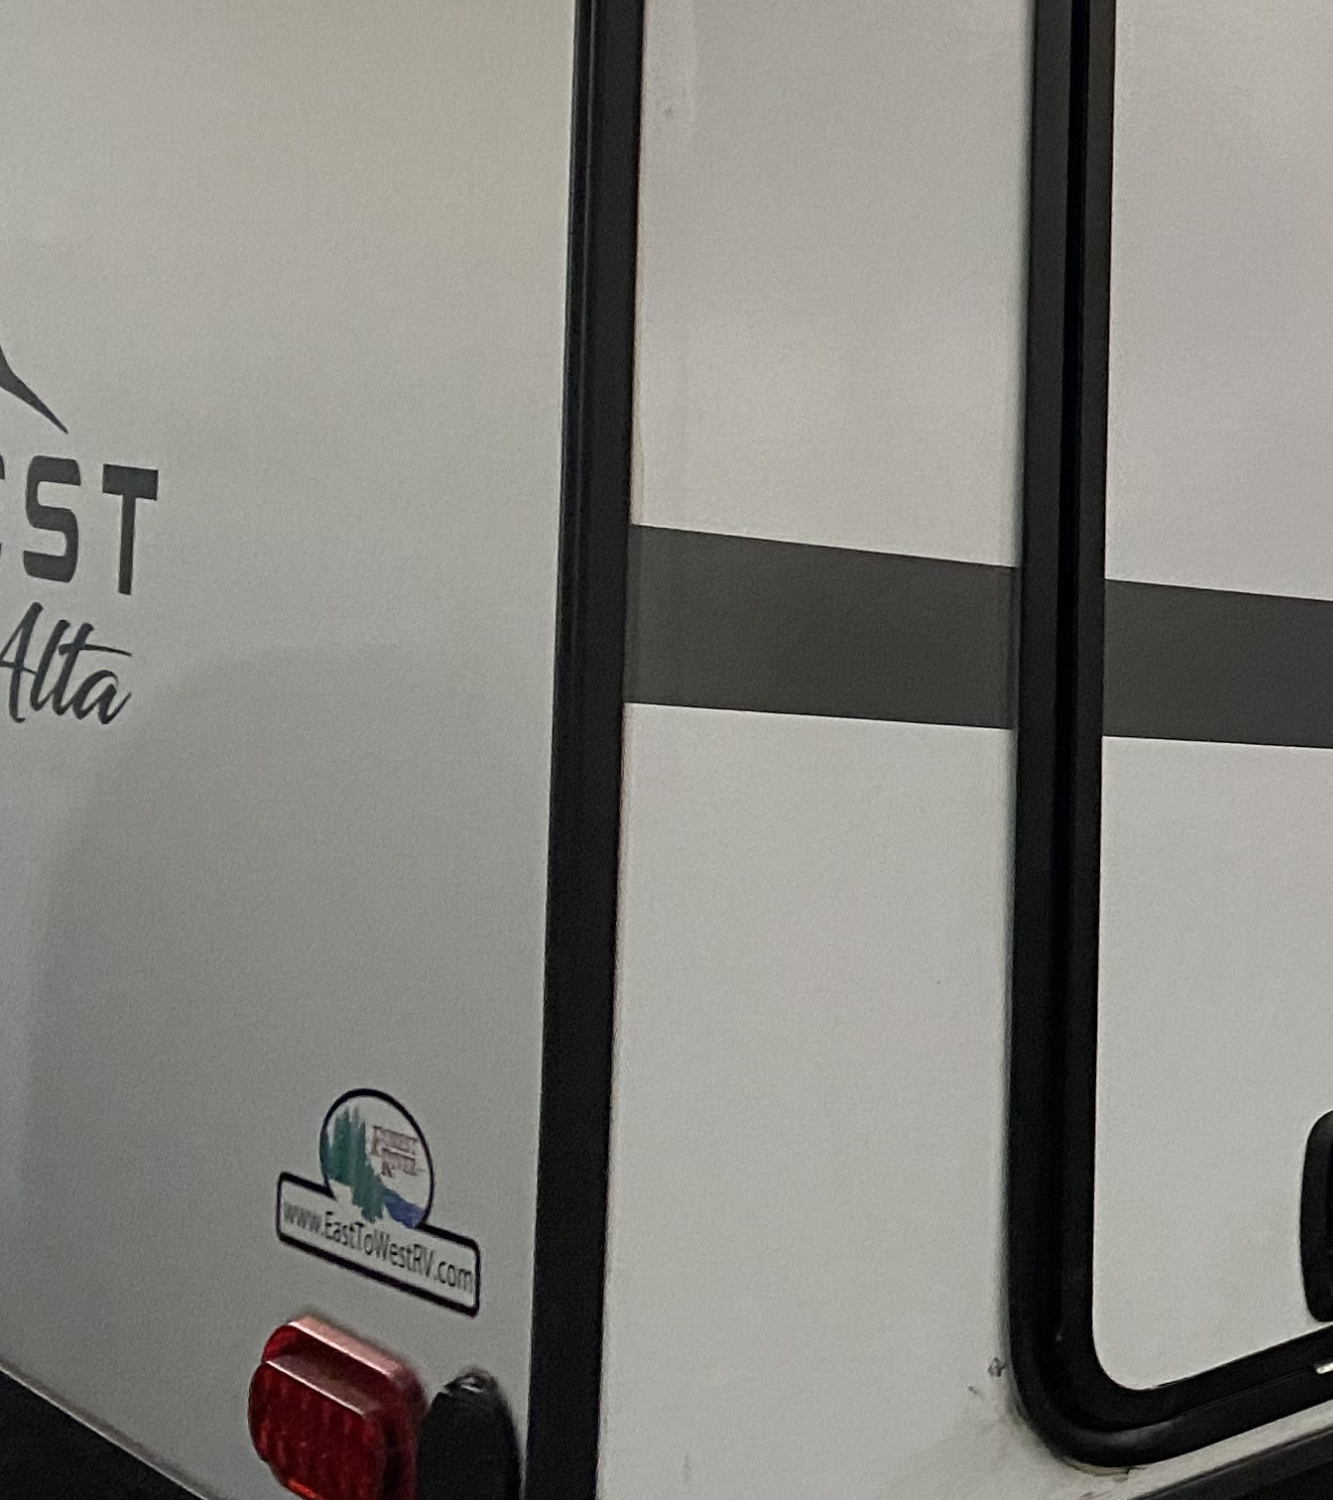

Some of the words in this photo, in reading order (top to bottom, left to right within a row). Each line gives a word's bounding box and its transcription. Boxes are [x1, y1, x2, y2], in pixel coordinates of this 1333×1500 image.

[0, 454, 160, 596] ST
[0, 601, 133, 724] Alta
[282, 1200, 474, 1295] www.EastToWestRV.com
